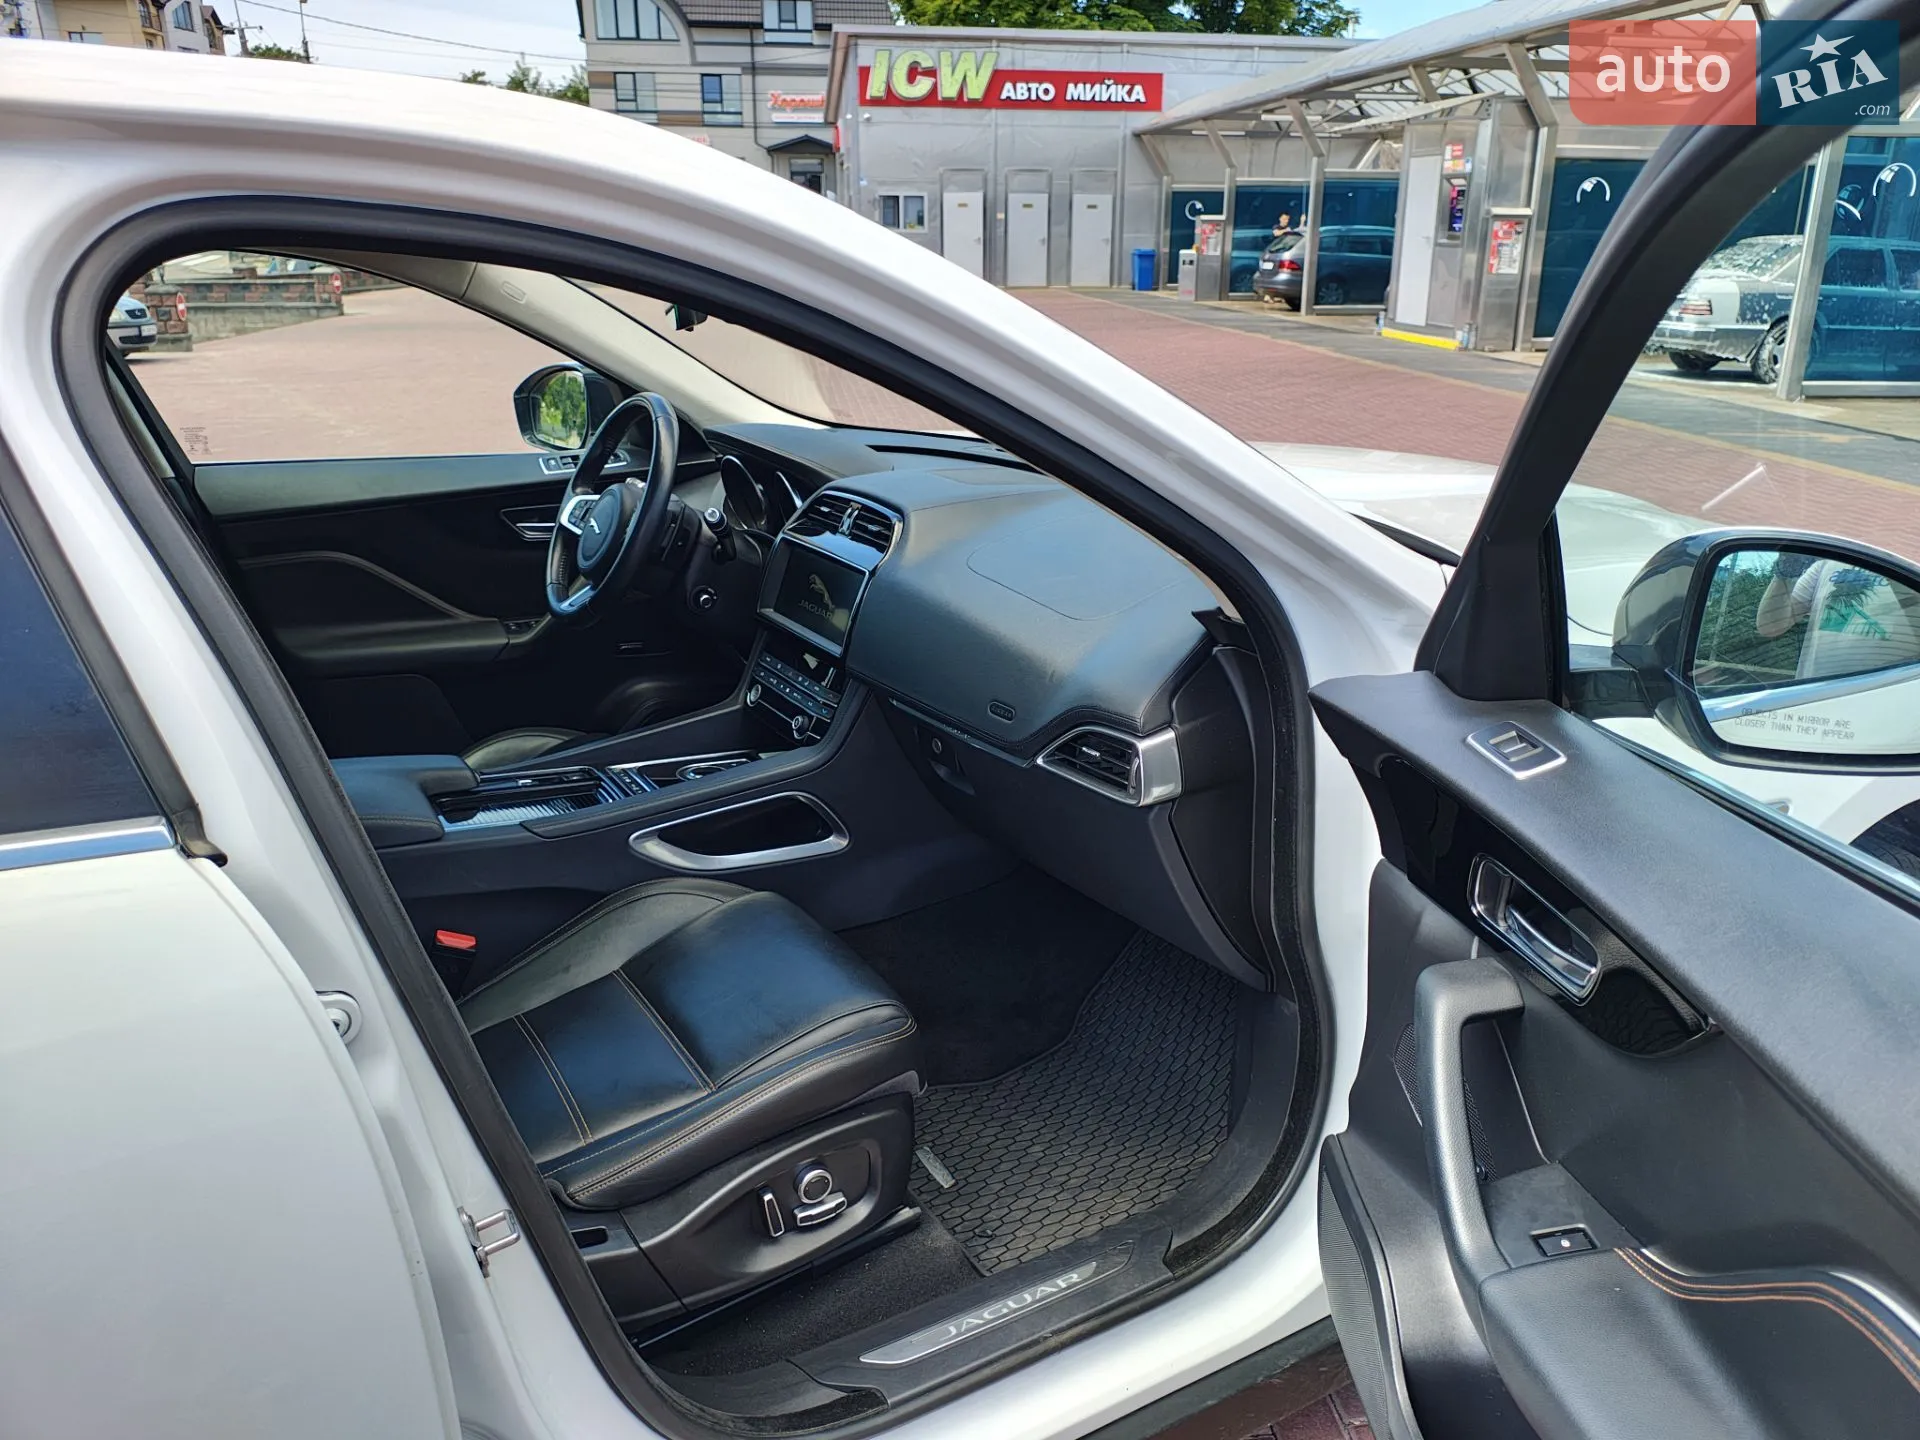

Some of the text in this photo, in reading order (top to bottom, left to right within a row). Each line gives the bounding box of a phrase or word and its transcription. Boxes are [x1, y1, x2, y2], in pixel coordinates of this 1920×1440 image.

[866, 48, 998, 101] ICW
[1000, 79, 1147, 103] АВТО МИЙКА
[1734, 717, 1855, 740] CLOSER THAN THEY APPEAR
[1783, 713, 1793, 721] IN
[1798, 715, 1831, 727] MIRROR
[1834, 720, 1851, 729] ARE
[939, 1272, 1082, 1341] JAGUAR
